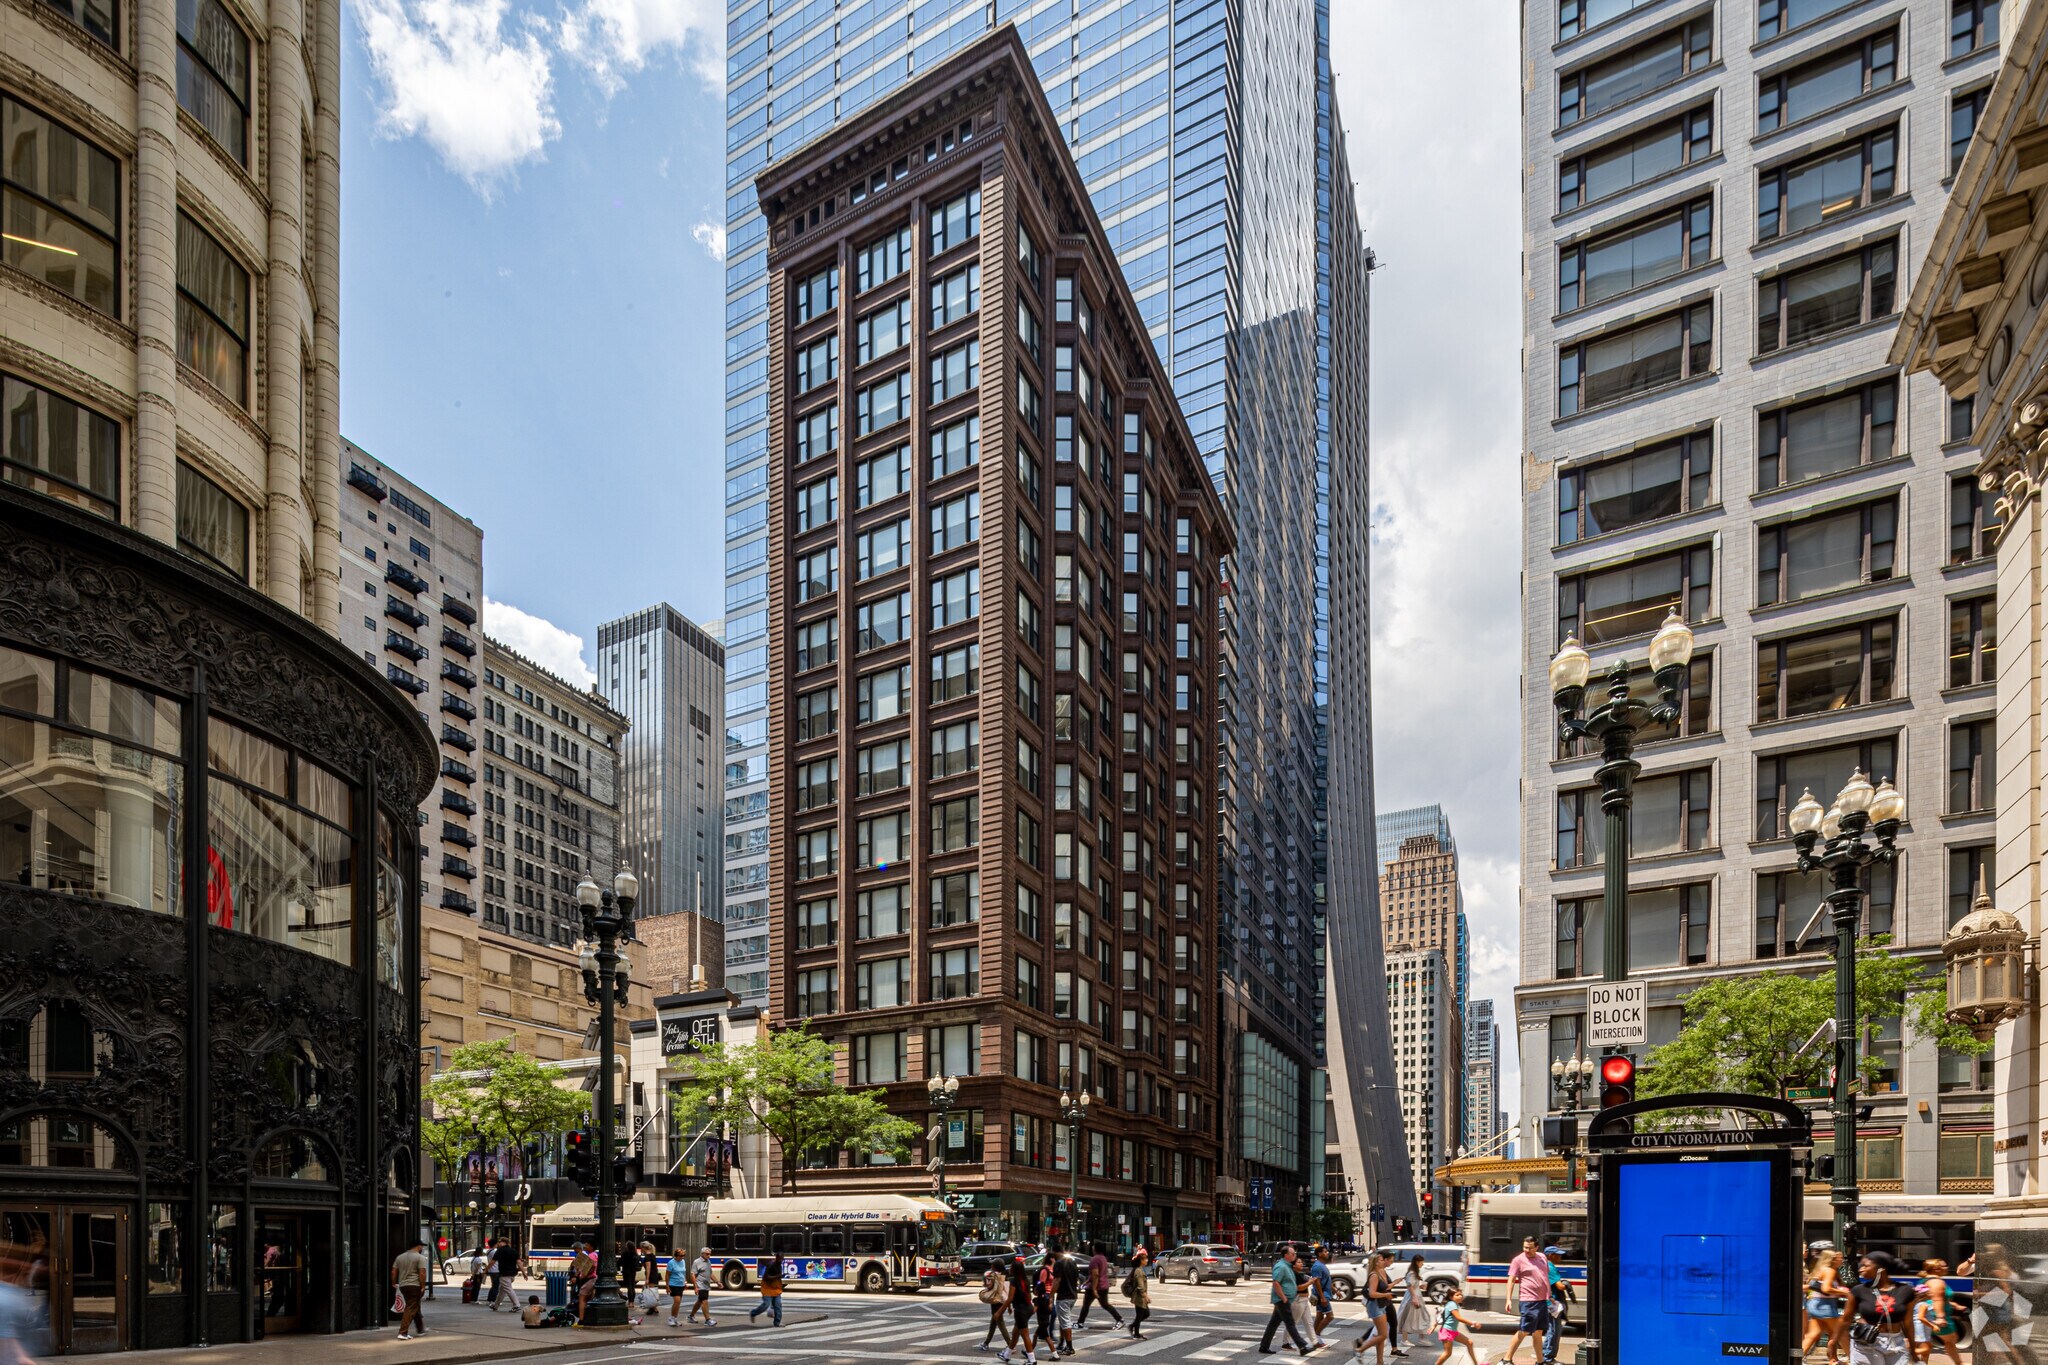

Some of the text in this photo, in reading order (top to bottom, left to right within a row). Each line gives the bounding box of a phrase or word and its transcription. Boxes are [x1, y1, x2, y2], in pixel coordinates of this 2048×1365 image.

[1592, 987, 1642, 1004] DO NOT
[1593, 1007, 1641, 1025] BLOCK
[692, 1018, 715, 1035] OFF
[1592, 1026, 1643, 1040] INTERSECTION
[692, 1032, 715, 1049] 5TH
[1631, 1131, 1755, 1147] CITY INFORMATION
[1252, 1187, 1258, 1196] 4
[1264, 1187, 1272, 1196] 0
[840, 1212, 864, 1220] Hybrid
[1727, 1345, 1763, 1354] AWAY
